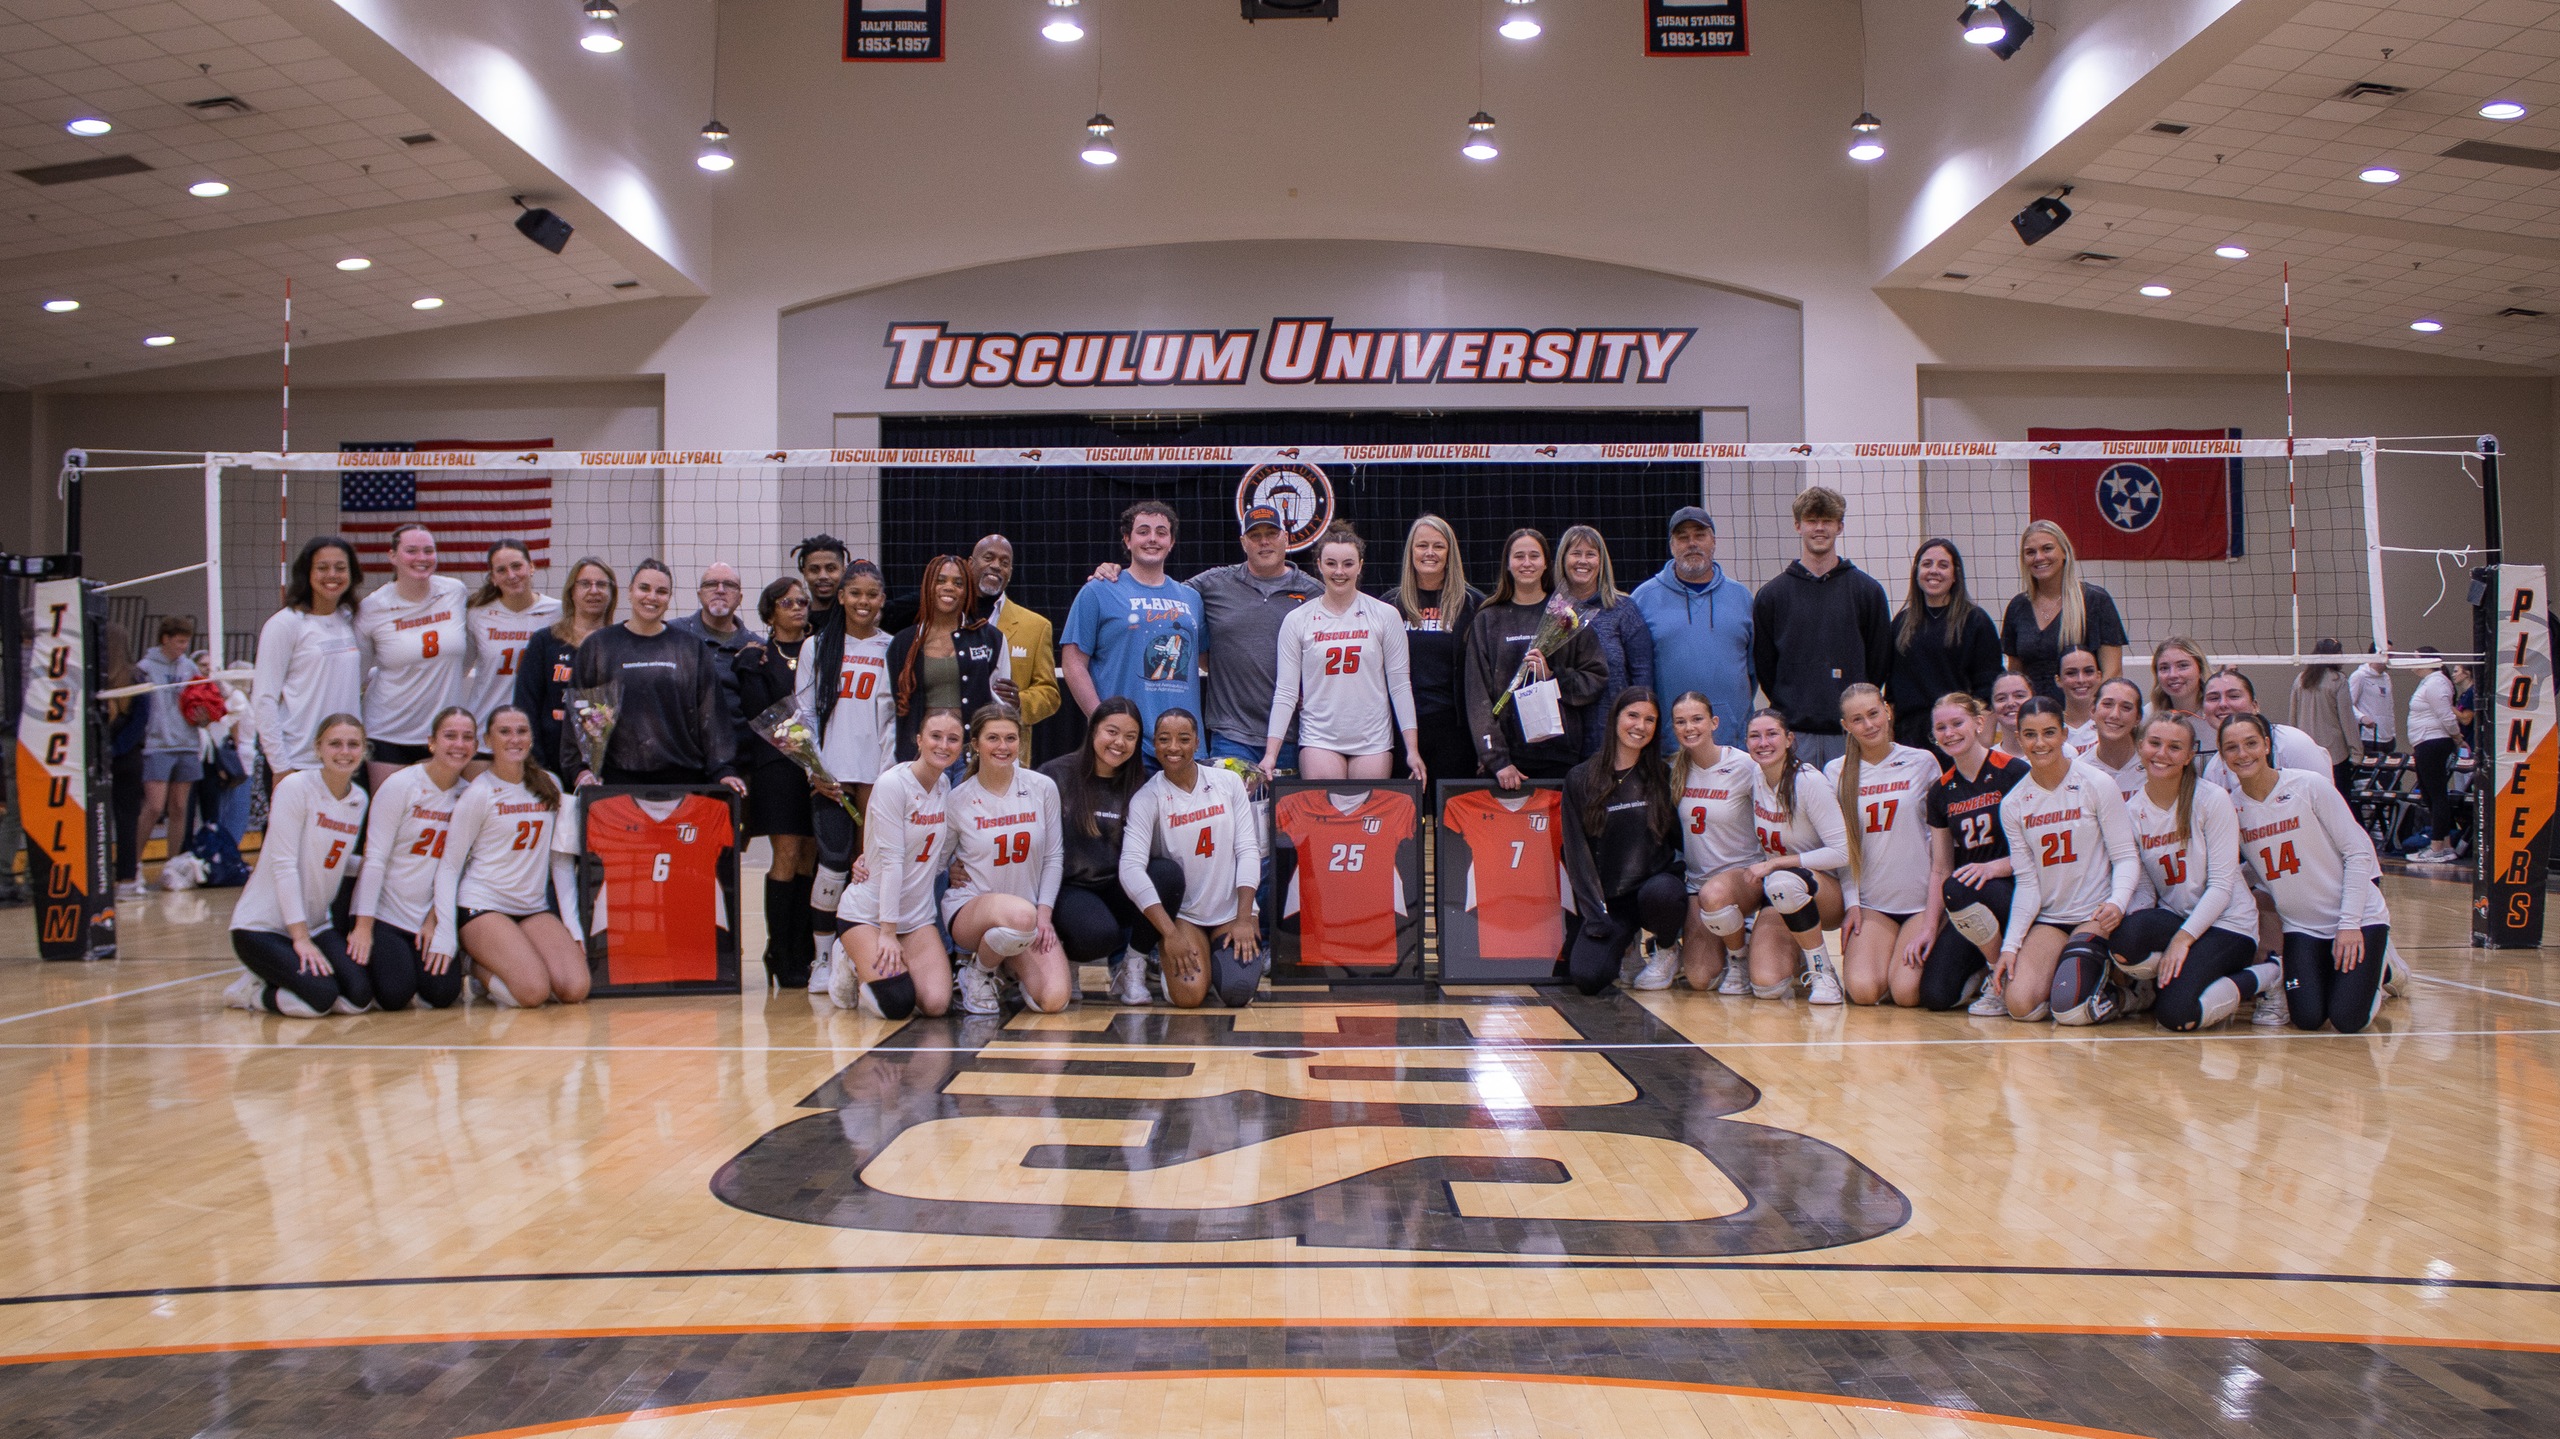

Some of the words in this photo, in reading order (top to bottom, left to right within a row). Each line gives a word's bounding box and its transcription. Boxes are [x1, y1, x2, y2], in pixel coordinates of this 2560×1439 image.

[860, 21, 893, 32] RALPH
[894, 21, 928, 32] HORNE
[1656, 16, 1689, 27] SUSAN
[1690, 15, 1736, 27] STARNES
[858, 37, 931, 52] 1953-1957
[1661, 31, 1734, 47] 1993-1997
[887, 322, 1256, 388] TUSCULUM
[1266, 318, 1696, 386] UNIVERSITY
[579, 452, 646, 466] TUSCULUM
[649, 450, 723, 465] VOLLEYBALL
[829, 449, 898, 463] TUSCULUM
[902, 447, 976, 462] VOLLEYBALL
[1085, 446, 1154, 461] TUSCULUM
[1158, 446, 1233, 460] VOLLEYBALL
[1343, 444, 1411, 459] TUSCULUM
[1416, 443, 1491, 458] VOLLEYBALL
[1600, 443, 1668, 458] TUSCULUM
[1673, 443, 1747, 458] VOLLEYBALL
[1854, 442, 1920, 457] TUSCULUM
[1925, 442, 1998, 456] VOLLEYBALL
[2102, 438, 2167, 455] TUSCULUM
[2171, 437, 2242, 454] VOLLEYBALL
[336, 453, 401, 467] TUSCULUM
[404, 452, 476, 467] VOLLEYBALL
[1129, 597, 1192, 615] PLANET
[422, 630, 439, 659] 8
[1312, 629, 1369, 643] TUSCULUM
[1325, 645, 1362, 675] 25
[840, 670, 877, 700] 10
[1483, 734, 1493, 750] 7
[2507, 588, 2534, 929] PIONEERS
[44, 603, 81, 943] TUSCULUM
[1167, 804, 1225, 828] TUSCULUM
[1866, 799, 1899, 833] 17
[1947, 791, 2002, 816] PIONEERS
[974, 811, 1036, 830] TUSCULUM
[1362, 816, 1381, 834] TU
[1528, 813, 1548, 832] TU
[1691, 806, 1707, 834] 3
[1961, 813, 1994, 849] 22
[2023, 807, 2081, 829] TUSCULUM
[2240, 816, 2300, 844] TUSCULUM
[512, 820, 544, 850] 27
[676, 823, 697, 843] TU
[1195, 827, 1214, 858] 4
[1756, 826, 1787, 857] 24
[324, 840, 346, 869] 5
[915, 832, 935, 862] 1
[993, 831, 1031, 866] 19
[1328, 843, 1366, 872] 25
[1510, 840, 1525, 869] 7
[2041, 829, 2077, 867] 21
[652, 853, 671, 882] 6
[2159, 849, 2187, 886] 15
[2260, 840, 2301, 881] 14
